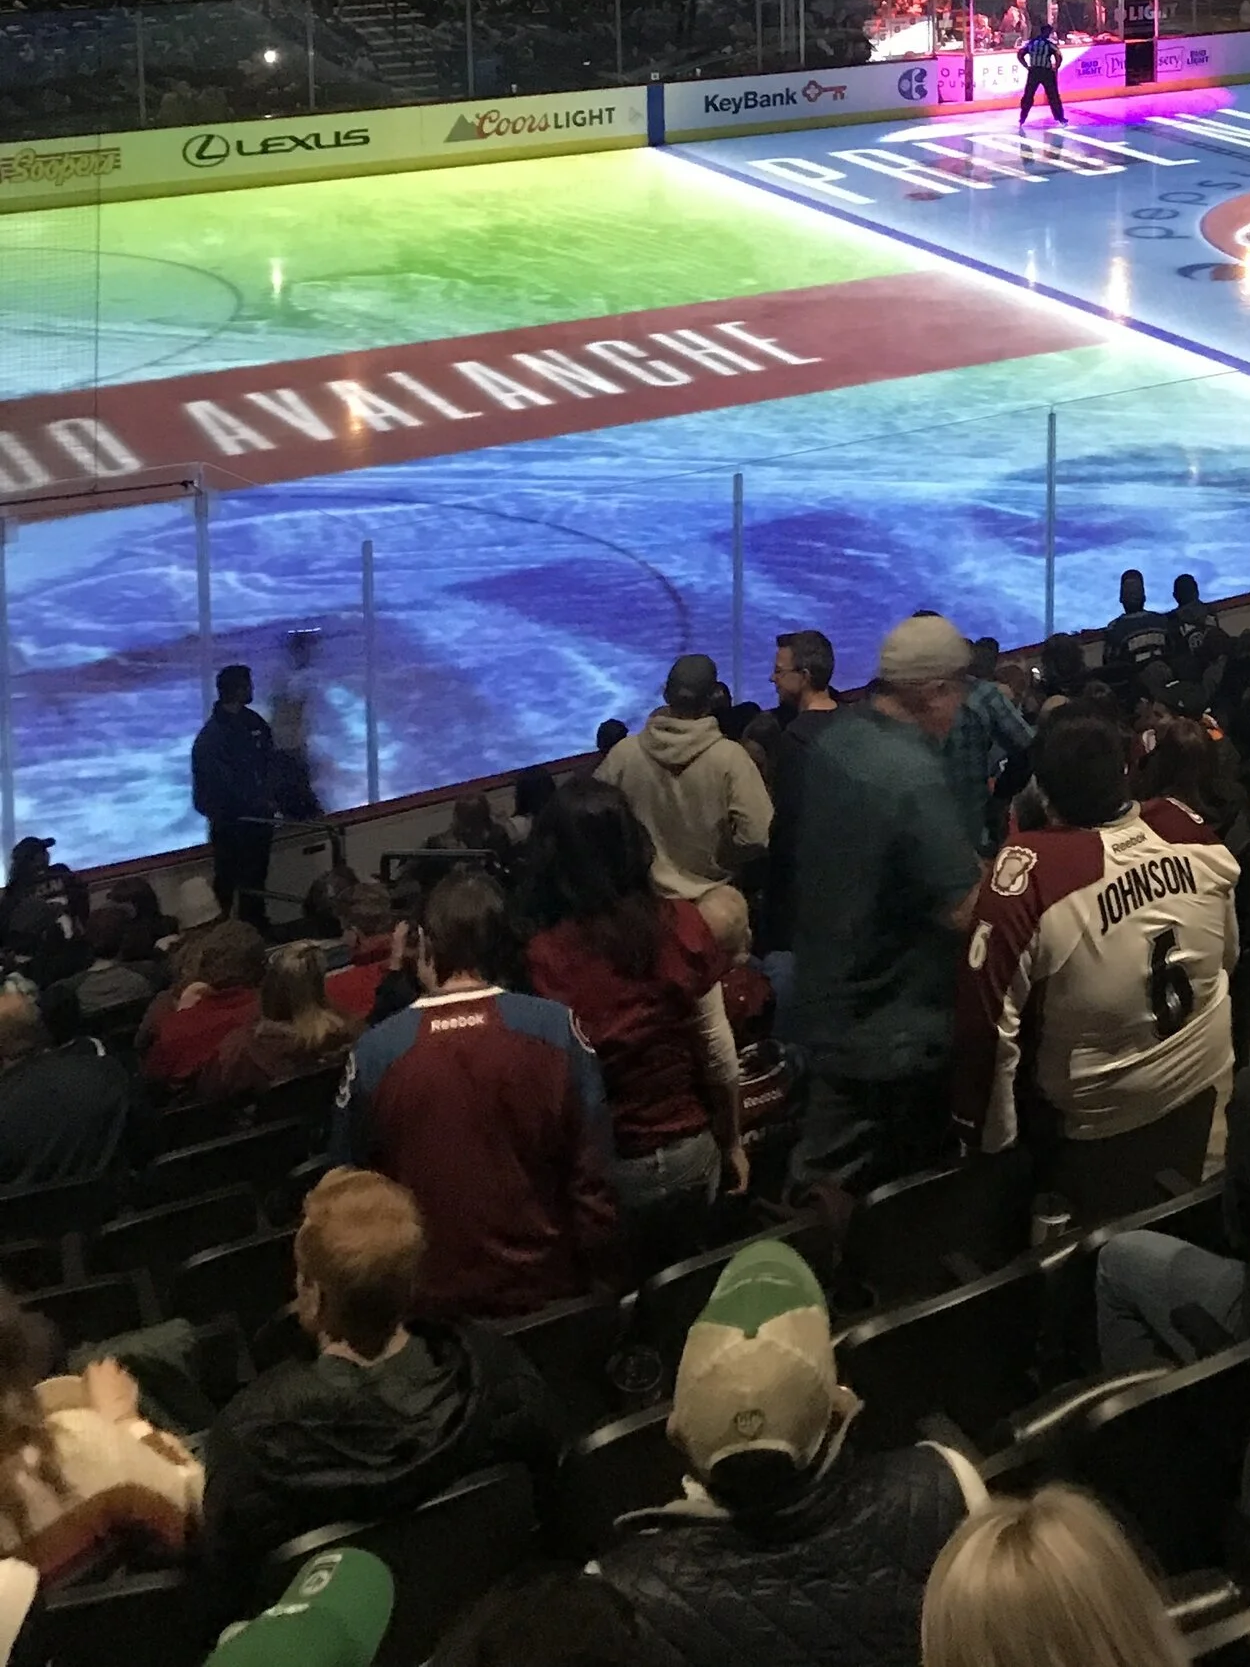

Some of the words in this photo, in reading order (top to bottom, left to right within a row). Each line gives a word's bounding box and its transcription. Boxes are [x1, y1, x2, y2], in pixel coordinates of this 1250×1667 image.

[940, 65, 1019, 78] OPPER
[704, 90, 798, 115] KeyBank
[475, 109, 551, 140] Coors
[553, 107, 617, 130] LIGHT
[236, 129, 371, 157] LEXUS
[745, 126, 1202, 206] PRIDE
[182, 320, 825, 457] AVALANCHE
[1111, 832, 1148, 855] Reebok
[1097, 856, 1198, 935] JOHNSON
[1149, 928, 1195, 1042] 6
[430, 1013, 486, 1034] Reebok
